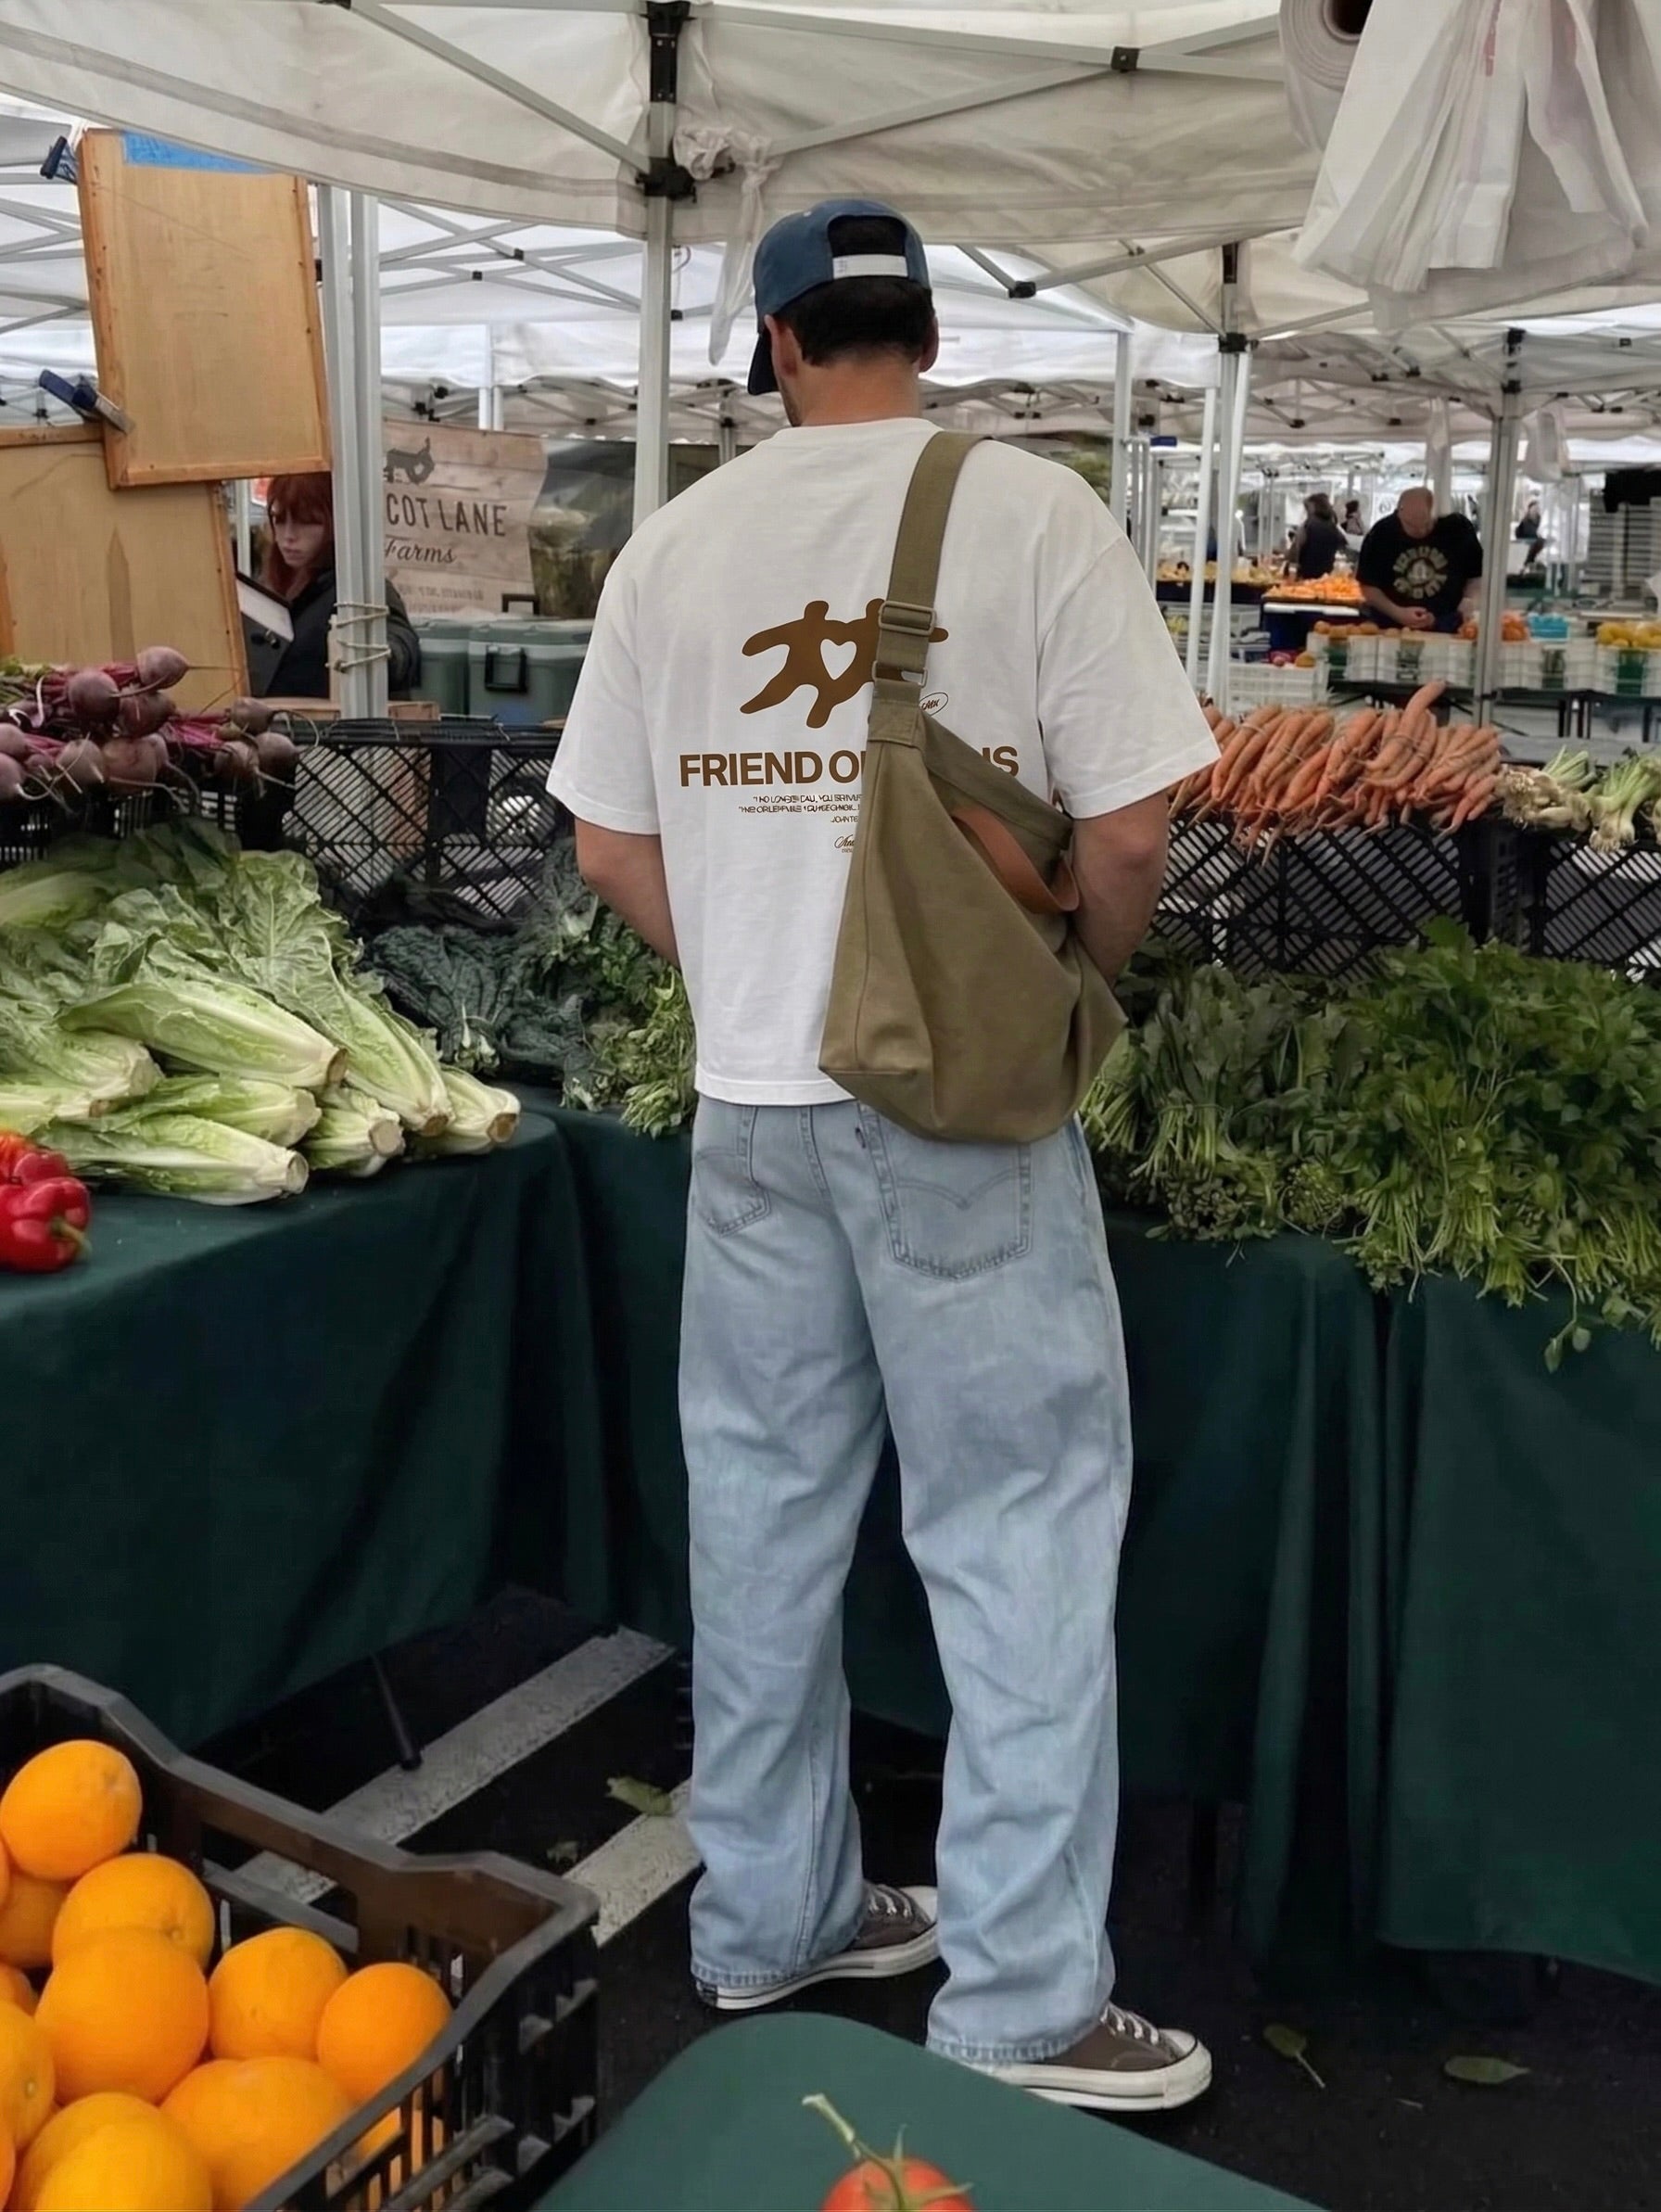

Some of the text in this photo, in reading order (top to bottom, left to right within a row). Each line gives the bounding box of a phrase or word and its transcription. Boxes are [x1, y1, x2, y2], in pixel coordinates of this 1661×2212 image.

[437, 499, 508, 537] LANE
[385, 534, 456, 564] Farms
[679, 750, 824, 787] FRIEND
